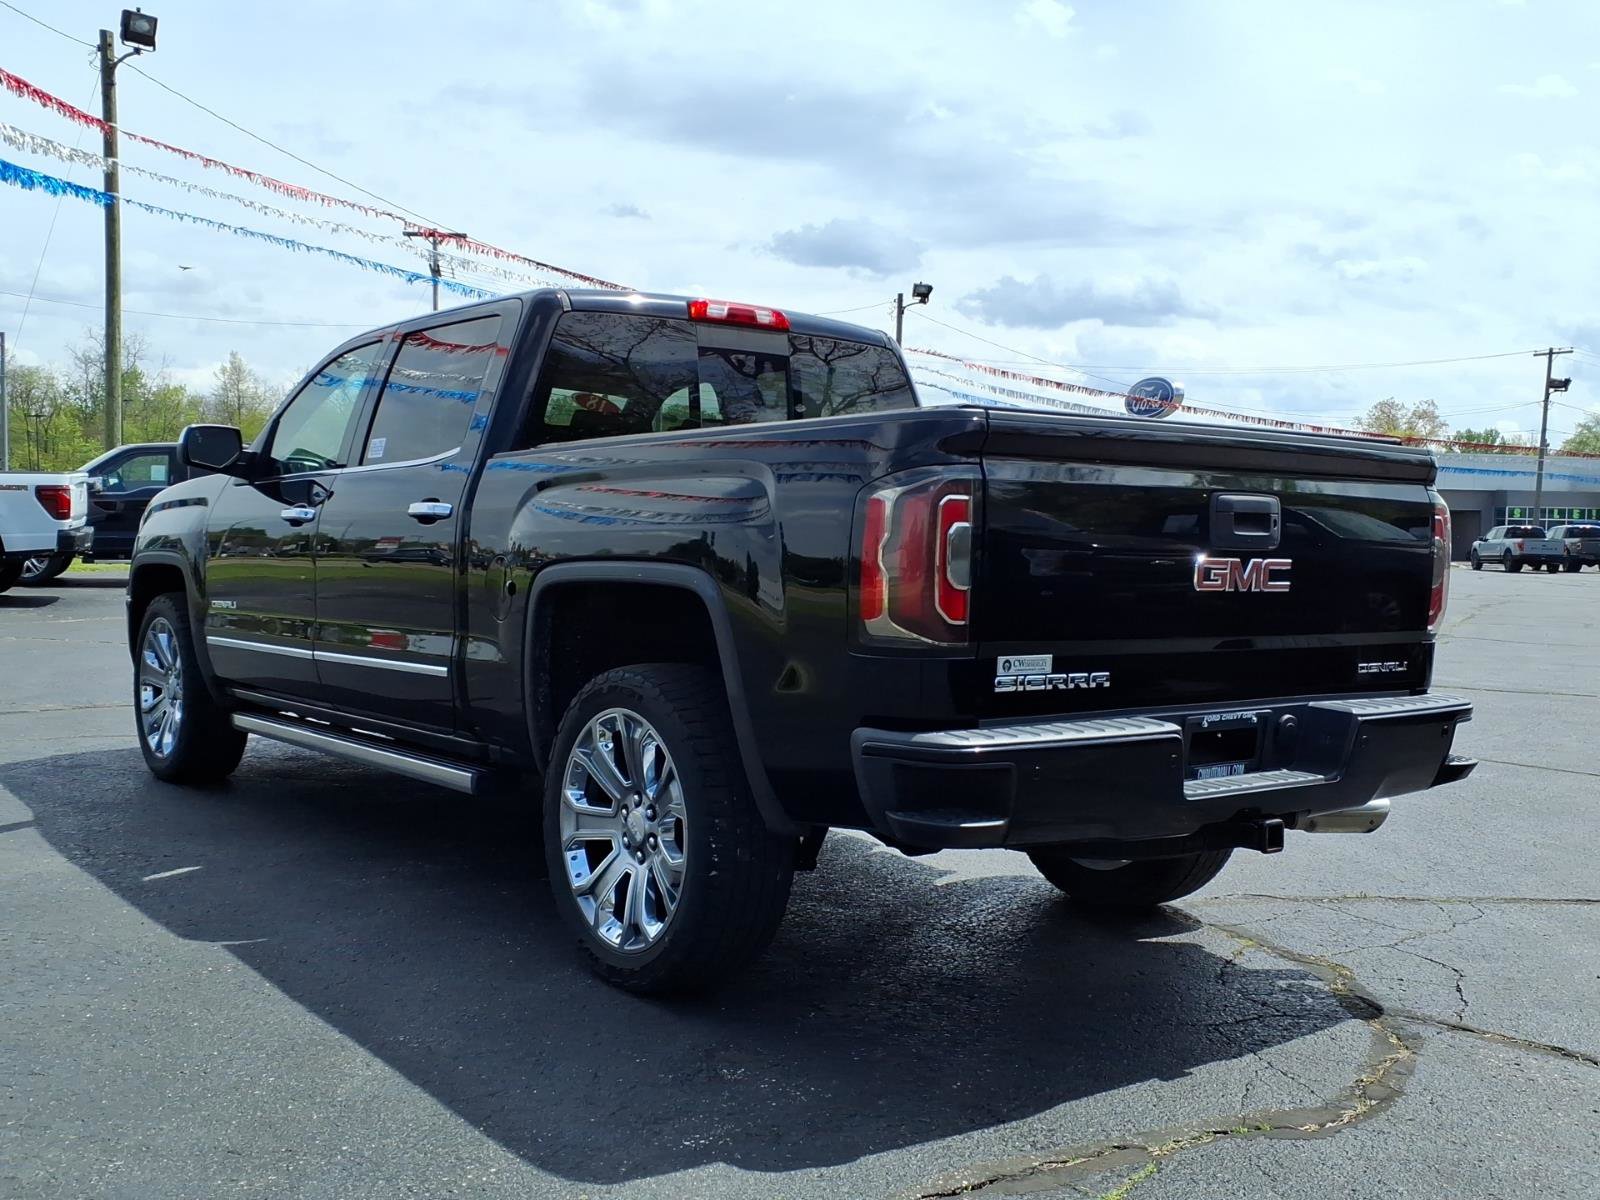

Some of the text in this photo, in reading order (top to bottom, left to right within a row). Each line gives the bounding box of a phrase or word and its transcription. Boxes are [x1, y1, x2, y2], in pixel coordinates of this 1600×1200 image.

[1131, 386, 1162, 412] Ford
[1513, 508, 1597, 519] SLE!
[1194, 557, 1292, 592] GMC
[1358, 661, 1408, 673] DENALI
[994, 672, 1110, 692] SIERRA
